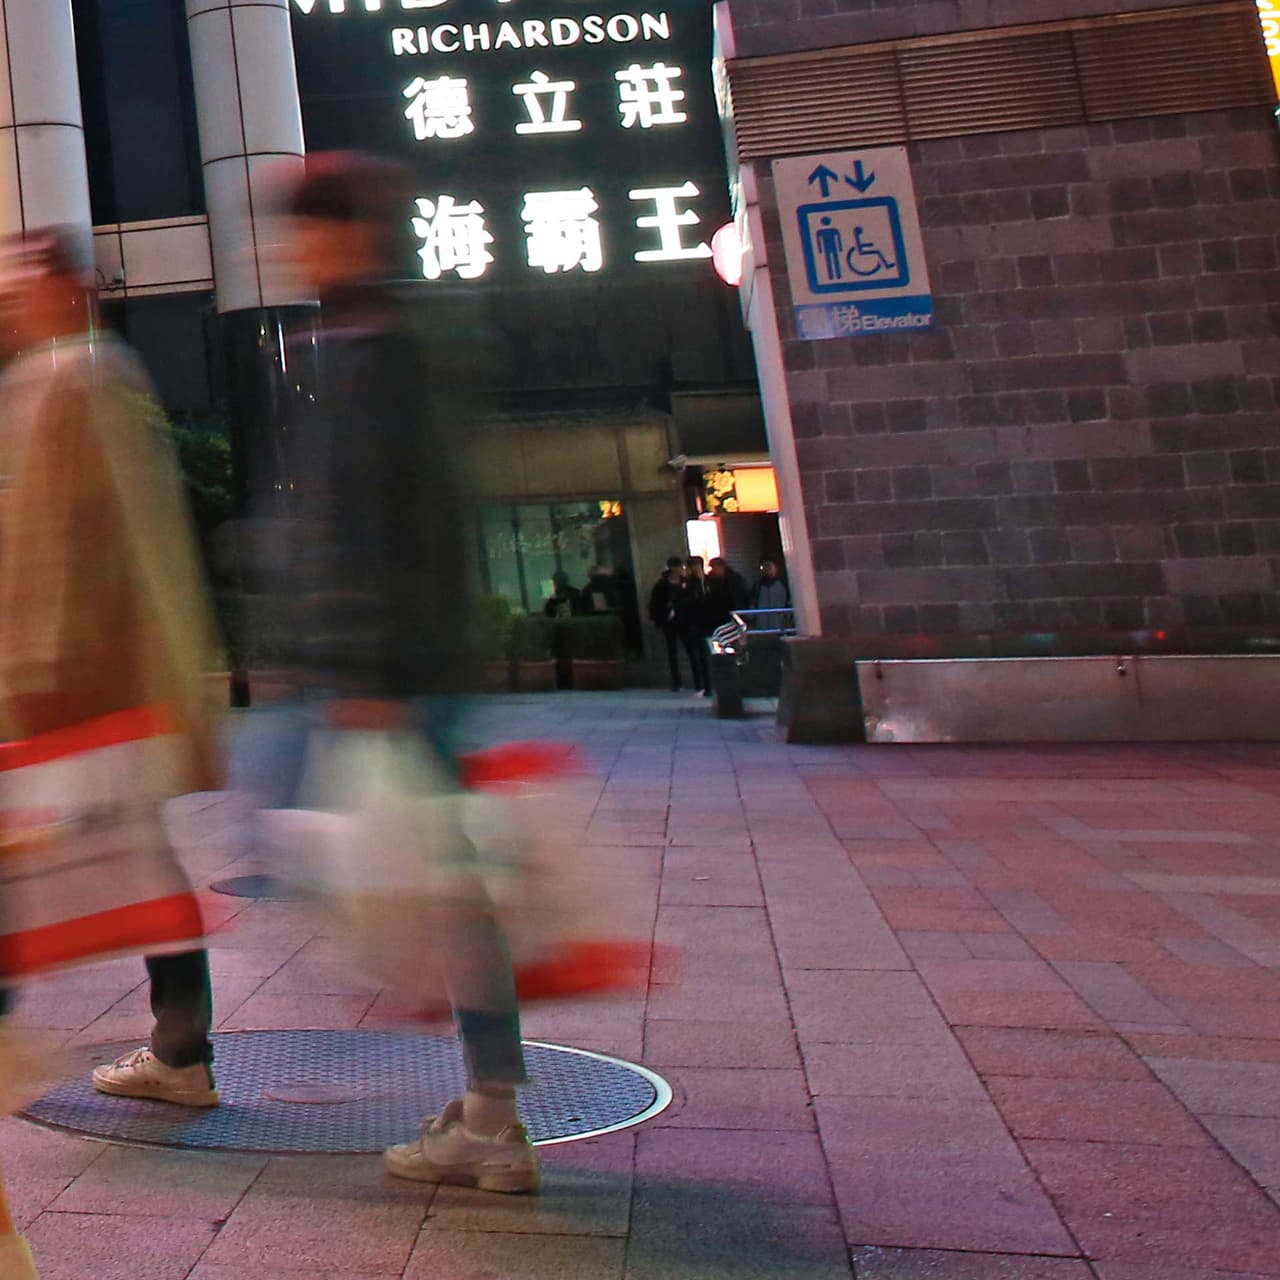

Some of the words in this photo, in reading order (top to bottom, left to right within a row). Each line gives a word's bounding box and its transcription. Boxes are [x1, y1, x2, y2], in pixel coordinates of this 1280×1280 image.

[391, 11, 671, 57] RICHARDSON
[402, 63, 688, 141] 德立莊
[410, 181, 713, 280] 海霸王
[863, 313, 932, 331] Elevator
